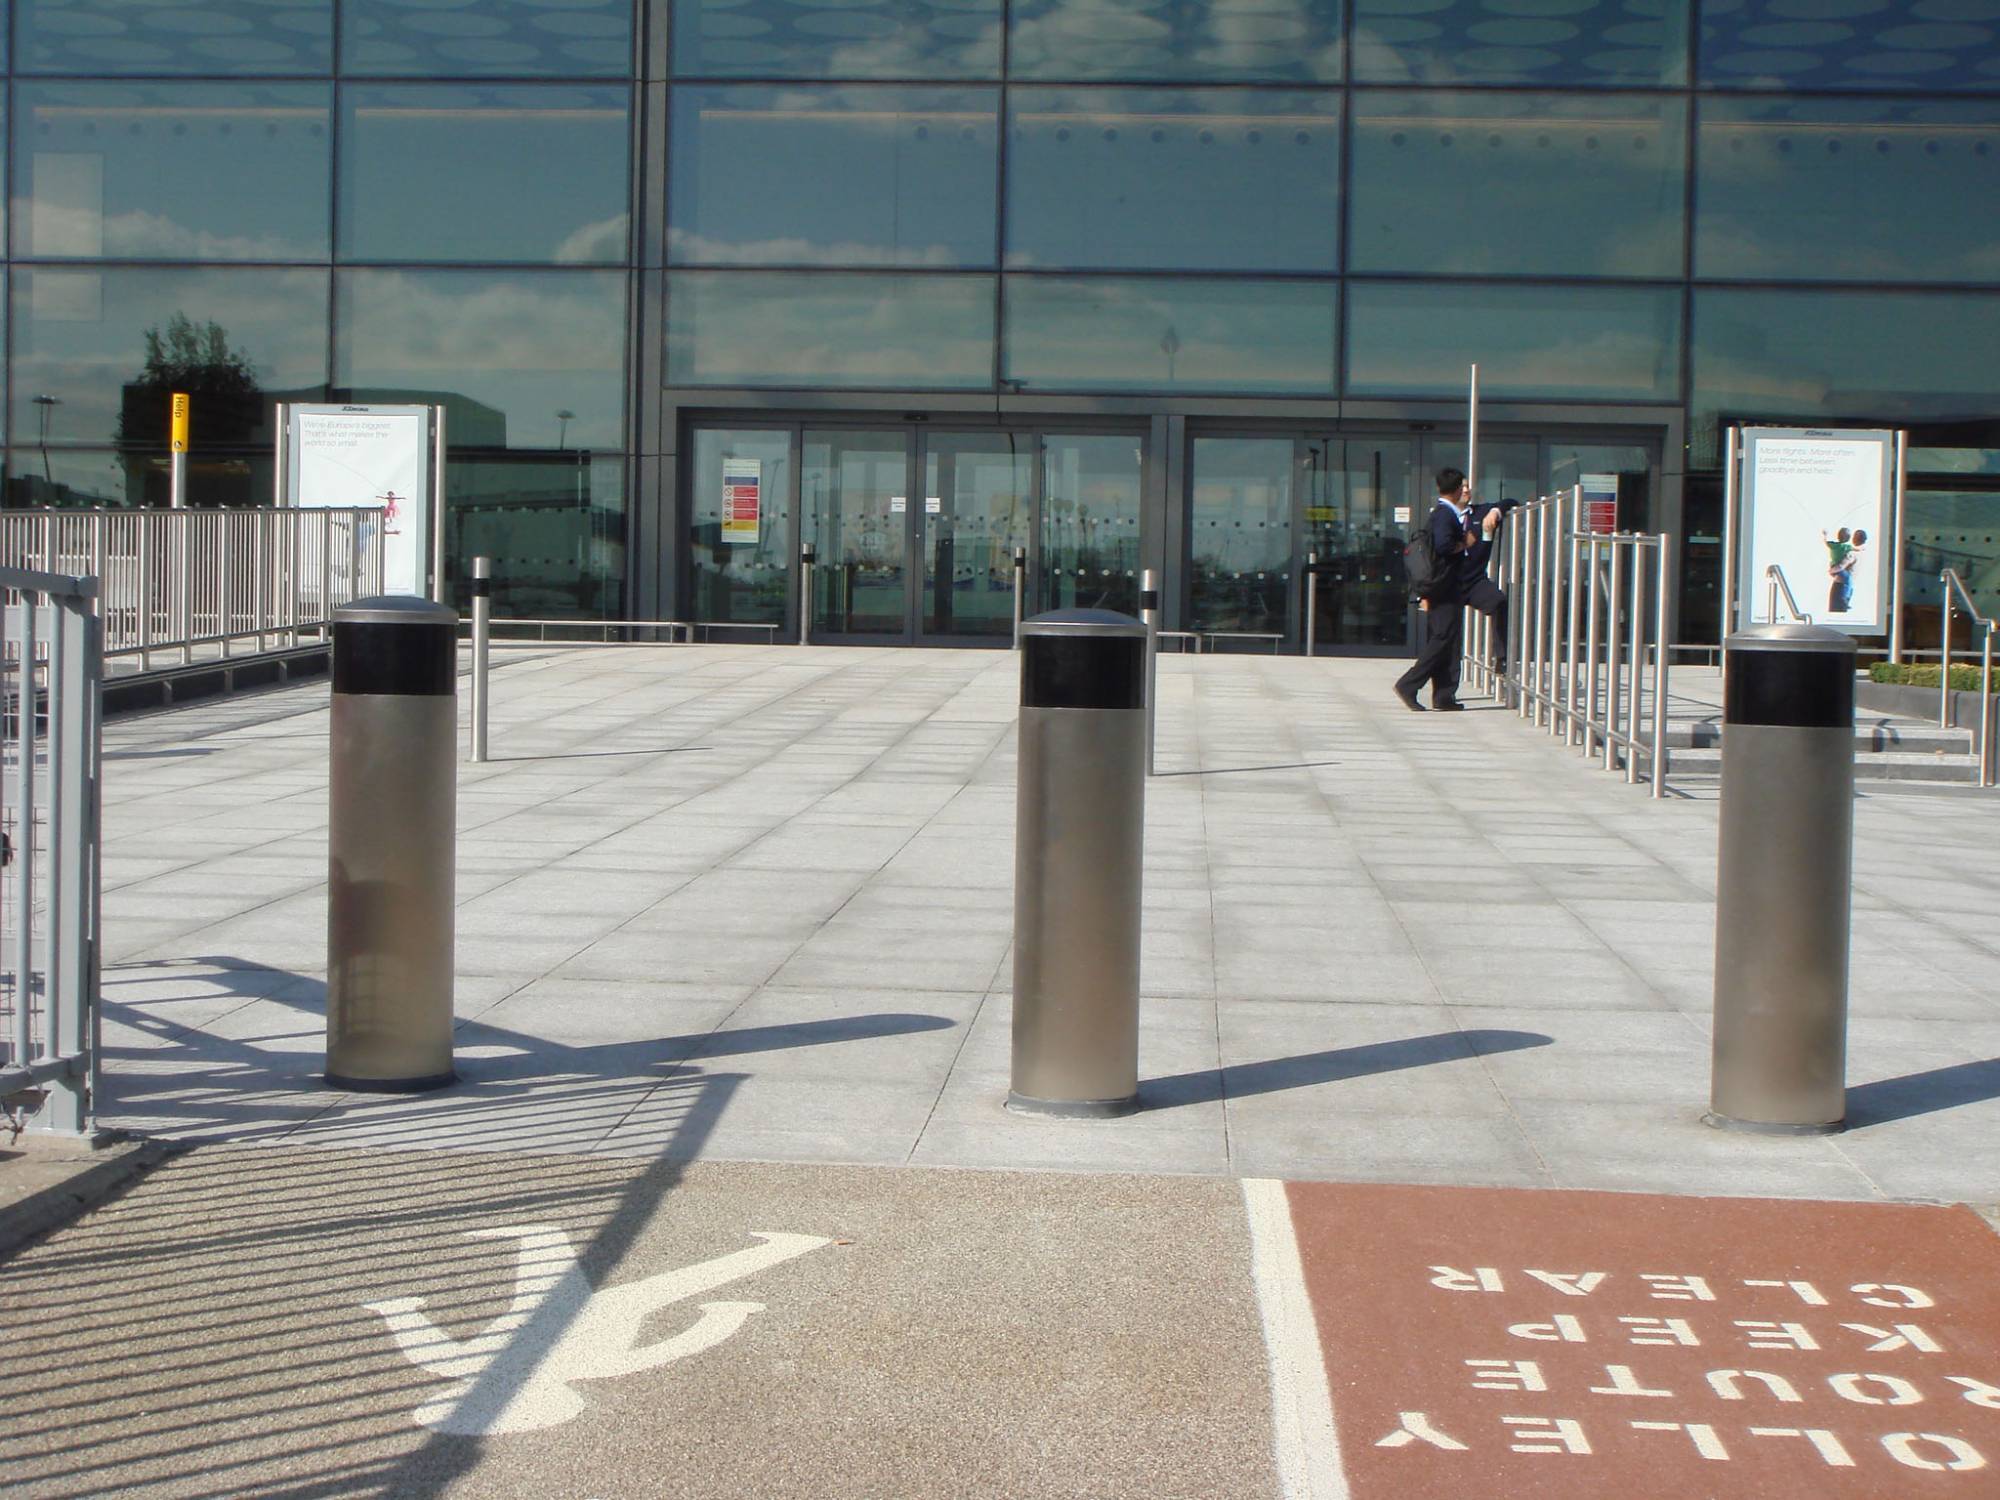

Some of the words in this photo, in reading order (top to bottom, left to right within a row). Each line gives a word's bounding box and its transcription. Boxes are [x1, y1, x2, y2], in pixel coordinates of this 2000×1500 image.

[174, 397, 185, 418] Help
[1427, 1265, 1934, 1309] CLEAR
[1507, 1314, 1943, 1353] KEEP
